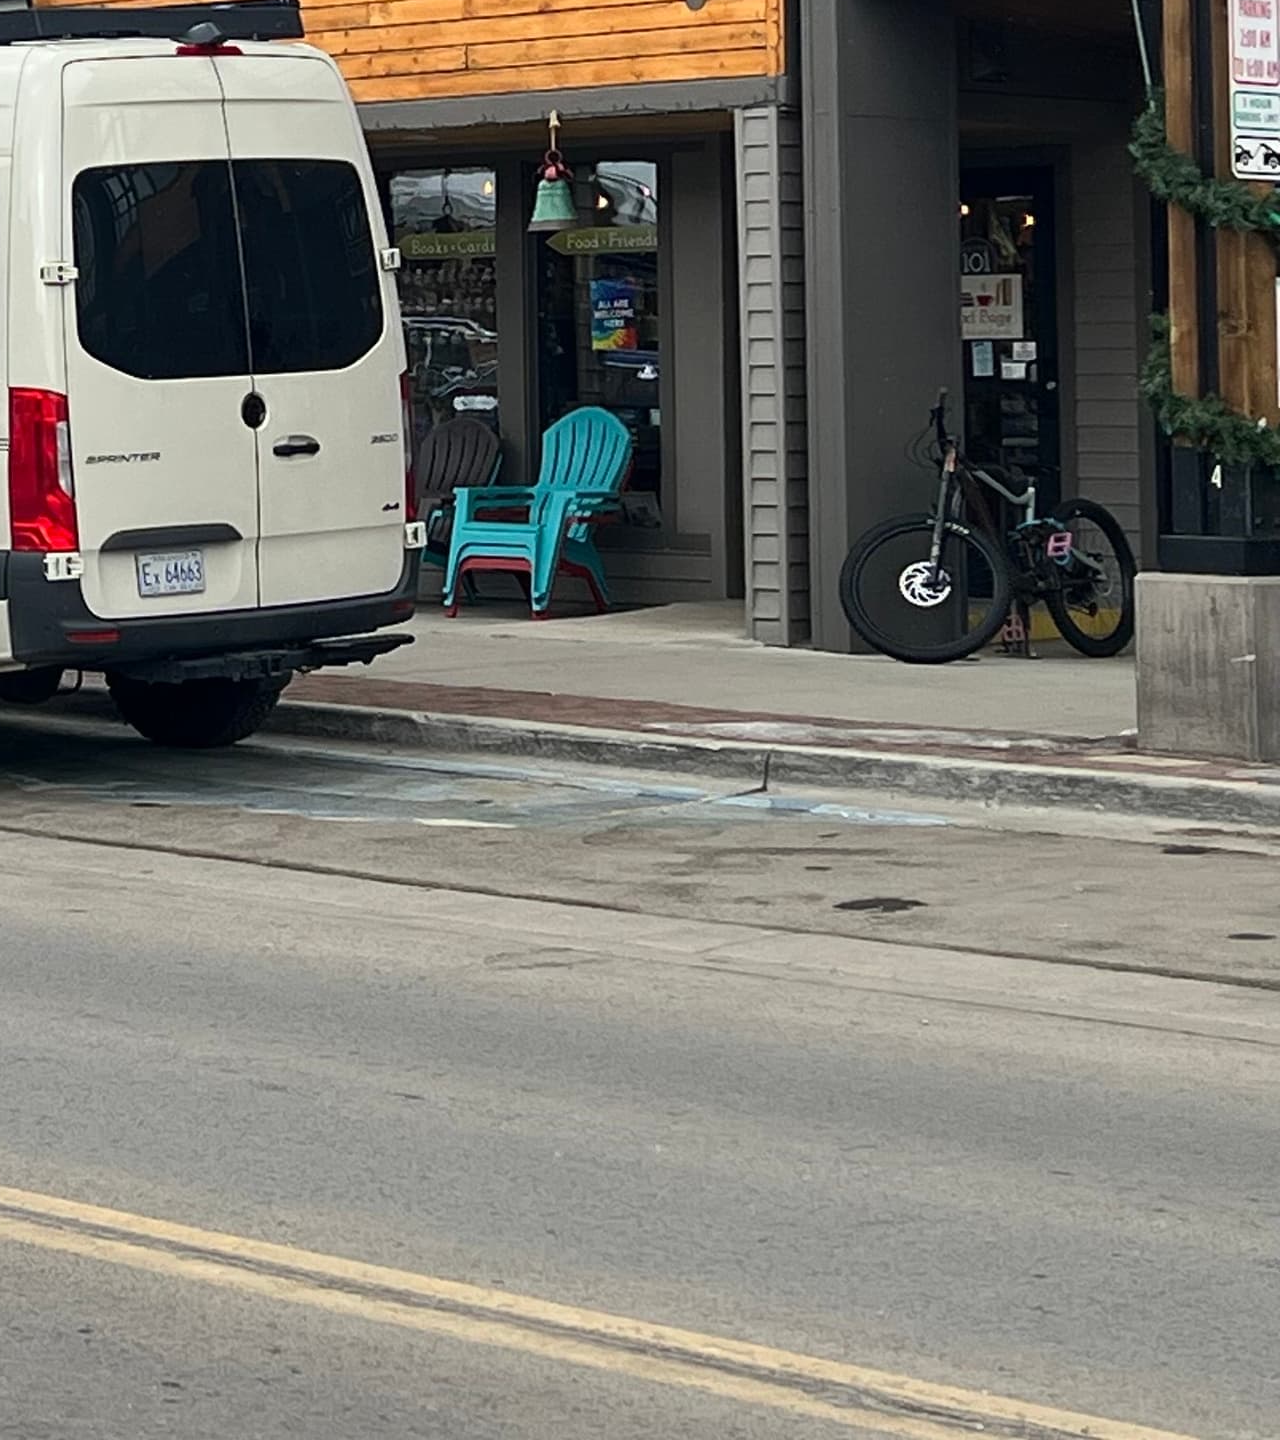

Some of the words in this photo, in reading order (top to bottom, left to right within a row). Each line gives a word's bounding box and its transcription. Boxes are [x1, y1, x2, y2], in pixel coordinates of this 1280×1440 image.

[412, 236, 449, 255] Books
[566, 233, 599, 249] Food
[962, 252, 991, 273] 101
[614, 299, 629, 309] ARE
[593, 309, 634, 319] WELCOME
[85, 452, 161, 465] SPRINTER
[1211, 464, 1222, 489] 4
